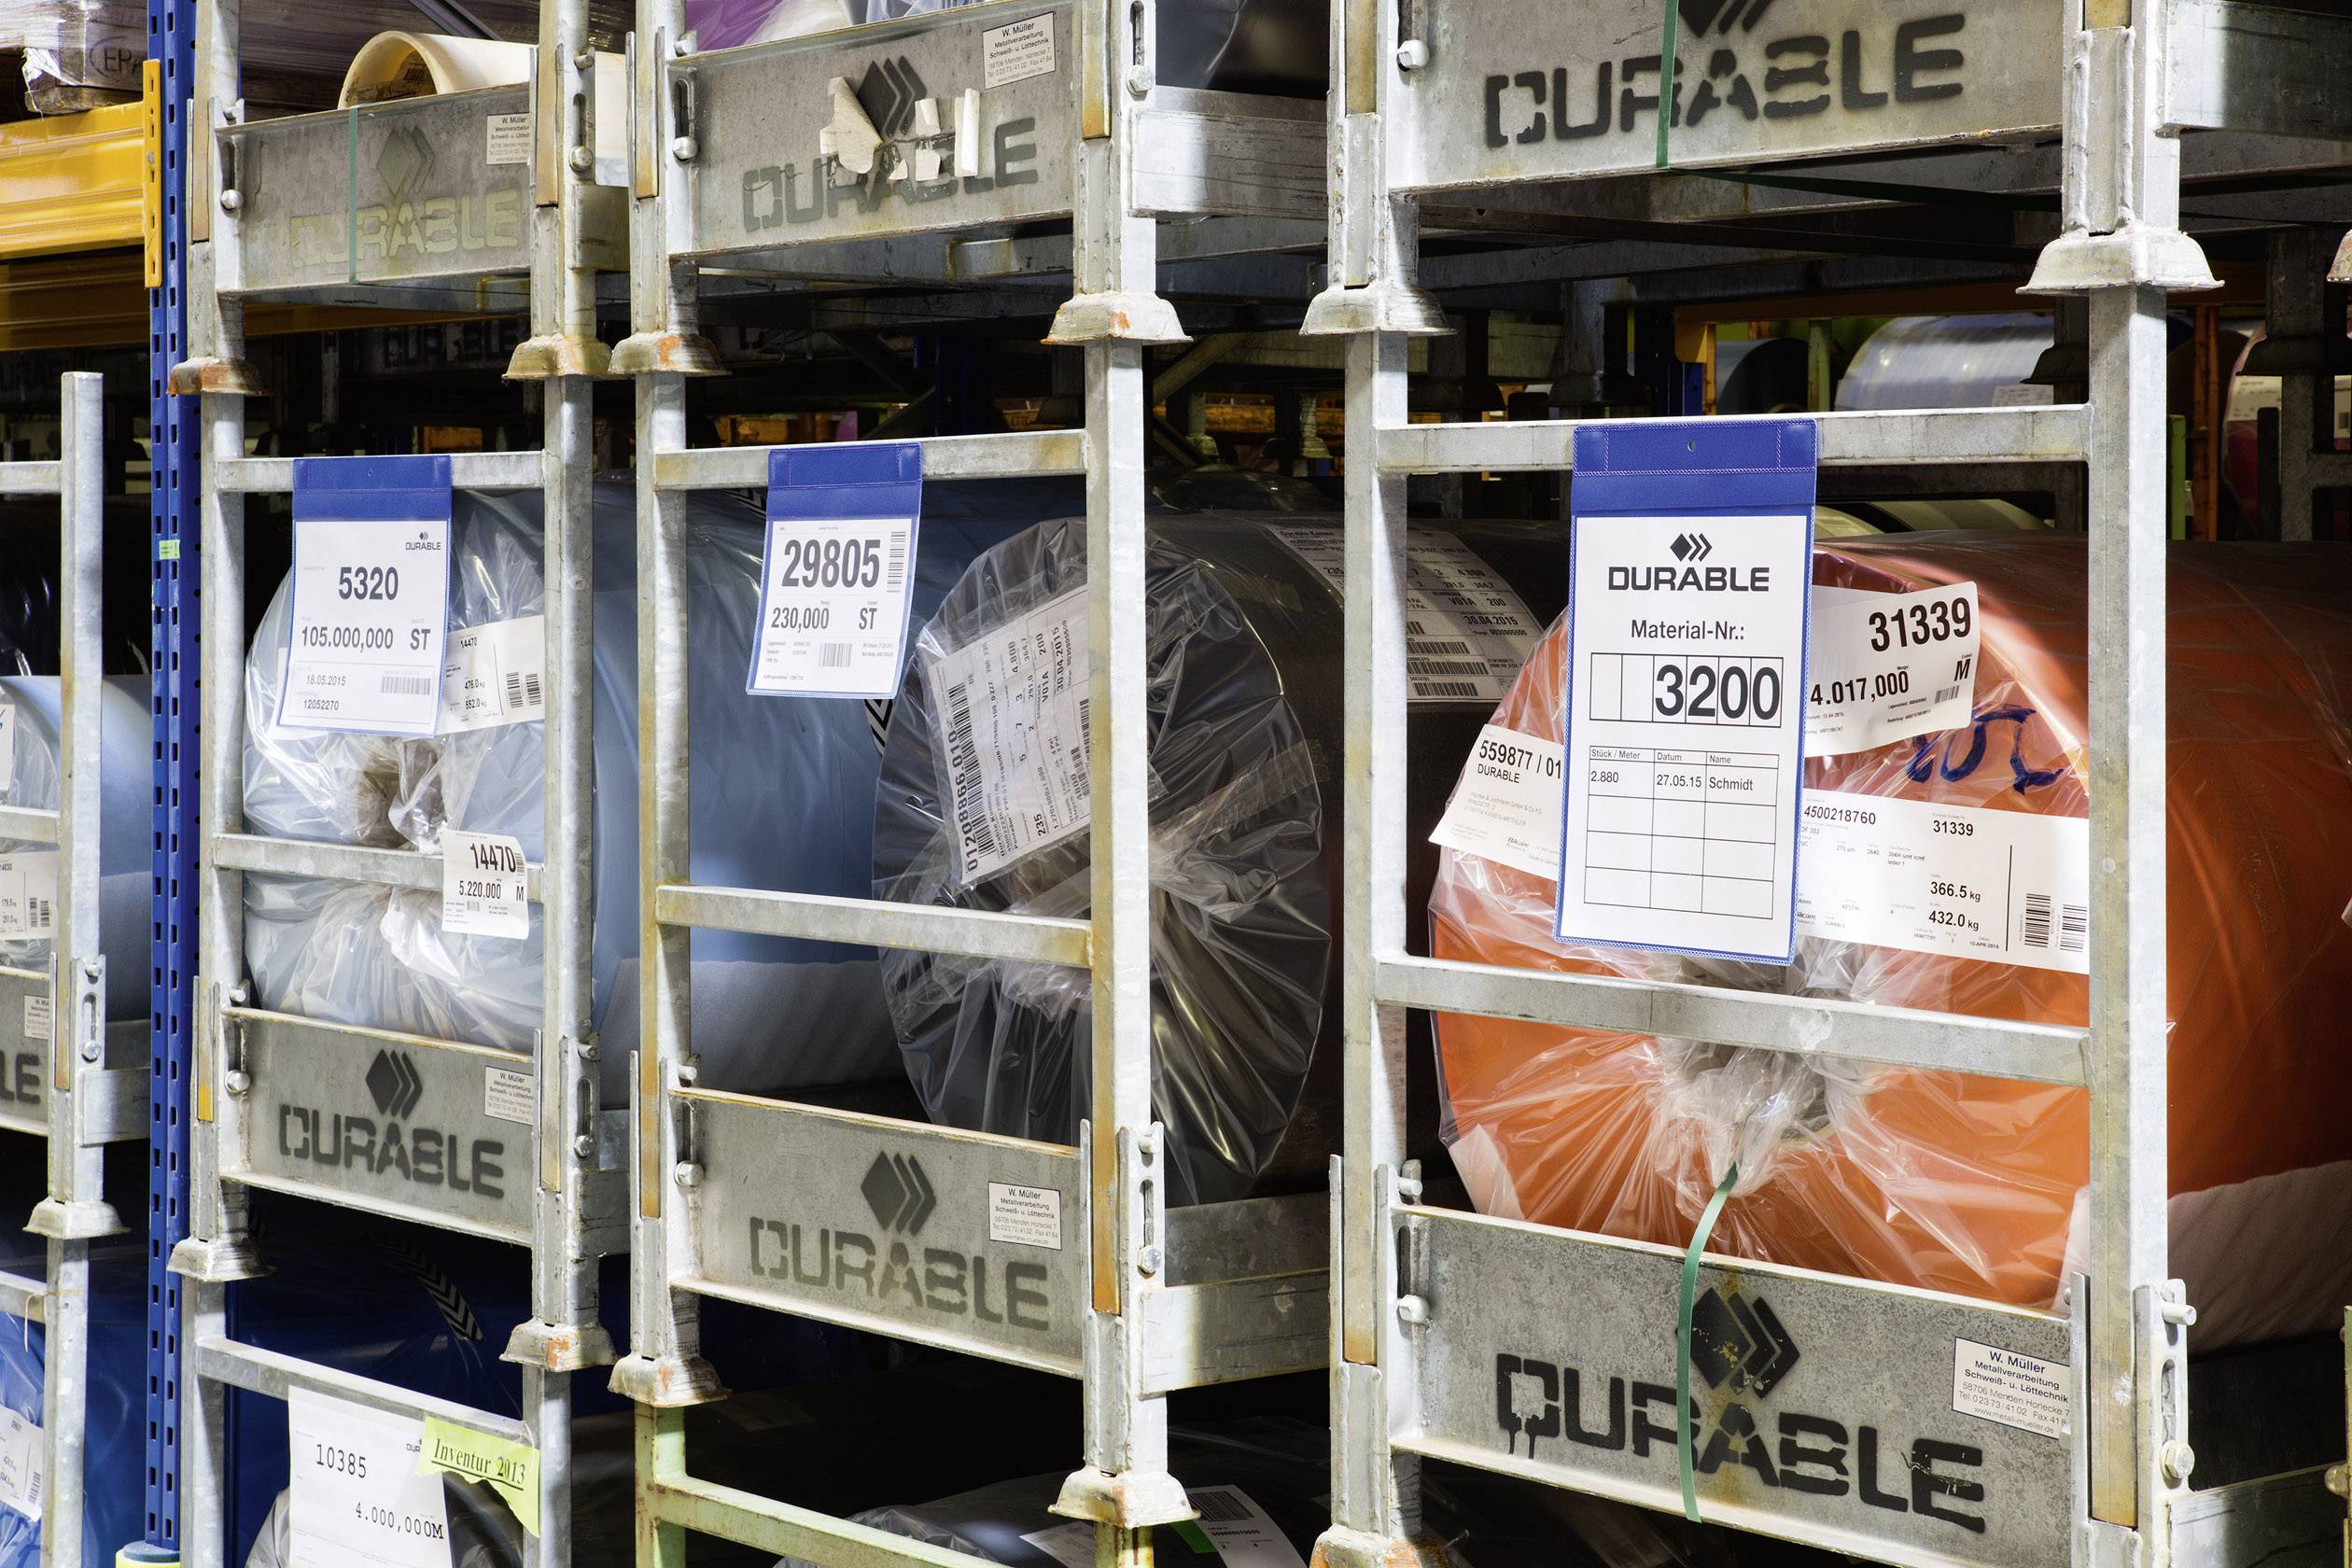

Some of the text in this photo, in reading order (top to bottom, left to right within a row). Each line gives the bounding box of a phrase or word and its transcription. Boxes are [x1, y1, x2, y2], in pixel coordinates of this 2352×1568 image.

[1001, 22, 1035, 37] W. Müller
[1486, 14, 1965, 148] DURABLE
[290, 187, 520, 270] DURABLE
[405, 541, 441, 551] DURABLE
[781, 539, 881, 588] 29805
[339, 566, 399, 600] 5320
[1608, 567, 1770, 592] DURABLE
[1486, 597, 1506, 607] 200
[771, 607, 877, 634] 230,000 ST
[1464, 615, 1519, 626] 30.04.2015
[1631, 619, 1744, 640] Material-Nr.:
[1869, 596, 1971, 652] 31339
[301, 626, 431, 652] 105.000,000 ST
[1034, 630, 1046, 657] 200
[1051, 623, 1065, 693] 30.04.2015
[306, 675, 346, 687] 18.05.2015
[1810, 658, 1971, 706] 4.017,000 M
[303, 698, 340, 710] 12052270
[1655, 665, 1781, 721] 3200
[1479, 739, 1533, 770] 559877
[1546, 758, 1561, 779] 01
[1591, 749, 1612, 759] Stück
[1618, 749, 1640, 760] Meter
[1657, 752, 1682, 762] Datum
[1709, 754, 1731, 764] Name
[1477, 763, 1520, 783] DURABLE
[1590, 771, 1619, 783] 2.880
[1656, 775, 1701, 788] 27.05.15
[1709, 777, 1753, 791] Schmidt
[1033, 809, 1046, 838] 235
[1804, 805, 1876, 825] 4500218760
[1933, 819, 1974, 836] 31339
[469, 843, 516, 873] 14470
[459, 880, 525, 902] 5.220,000 M
[1930, 881, 1981, 903] 366.5 kg
[1928, 910, 1980, 931] 432.0 kg
[279, 1104, 504, 1199] DURABLE
[1000, 1197, 1050, 1211] Metallverarbeitung
[1008, 1188, 1042, 1199] W. Müller
[750, 1216, 1048, 1331] DURABLE
[1989, 1351, 2046, 1374] W. Müller
[1965, 1368, 2007, 1386] Schweiß-
[2021, 1383, 2069, 1403] Löttechnik
[1975, 1360, 2060, 1391] Metallverarbeitung
[1963, 1381, 1988, 1395] 58706
[1990, 1388, 2023, 1405] Menden
[2033, 1410, 2048, 1421] Fax
[1496, 1353, 1985, 1533] DURABLE
[315, 1444, 367, 1478] 10385
[433, 1437, 526, 1485] Inventur 2013
